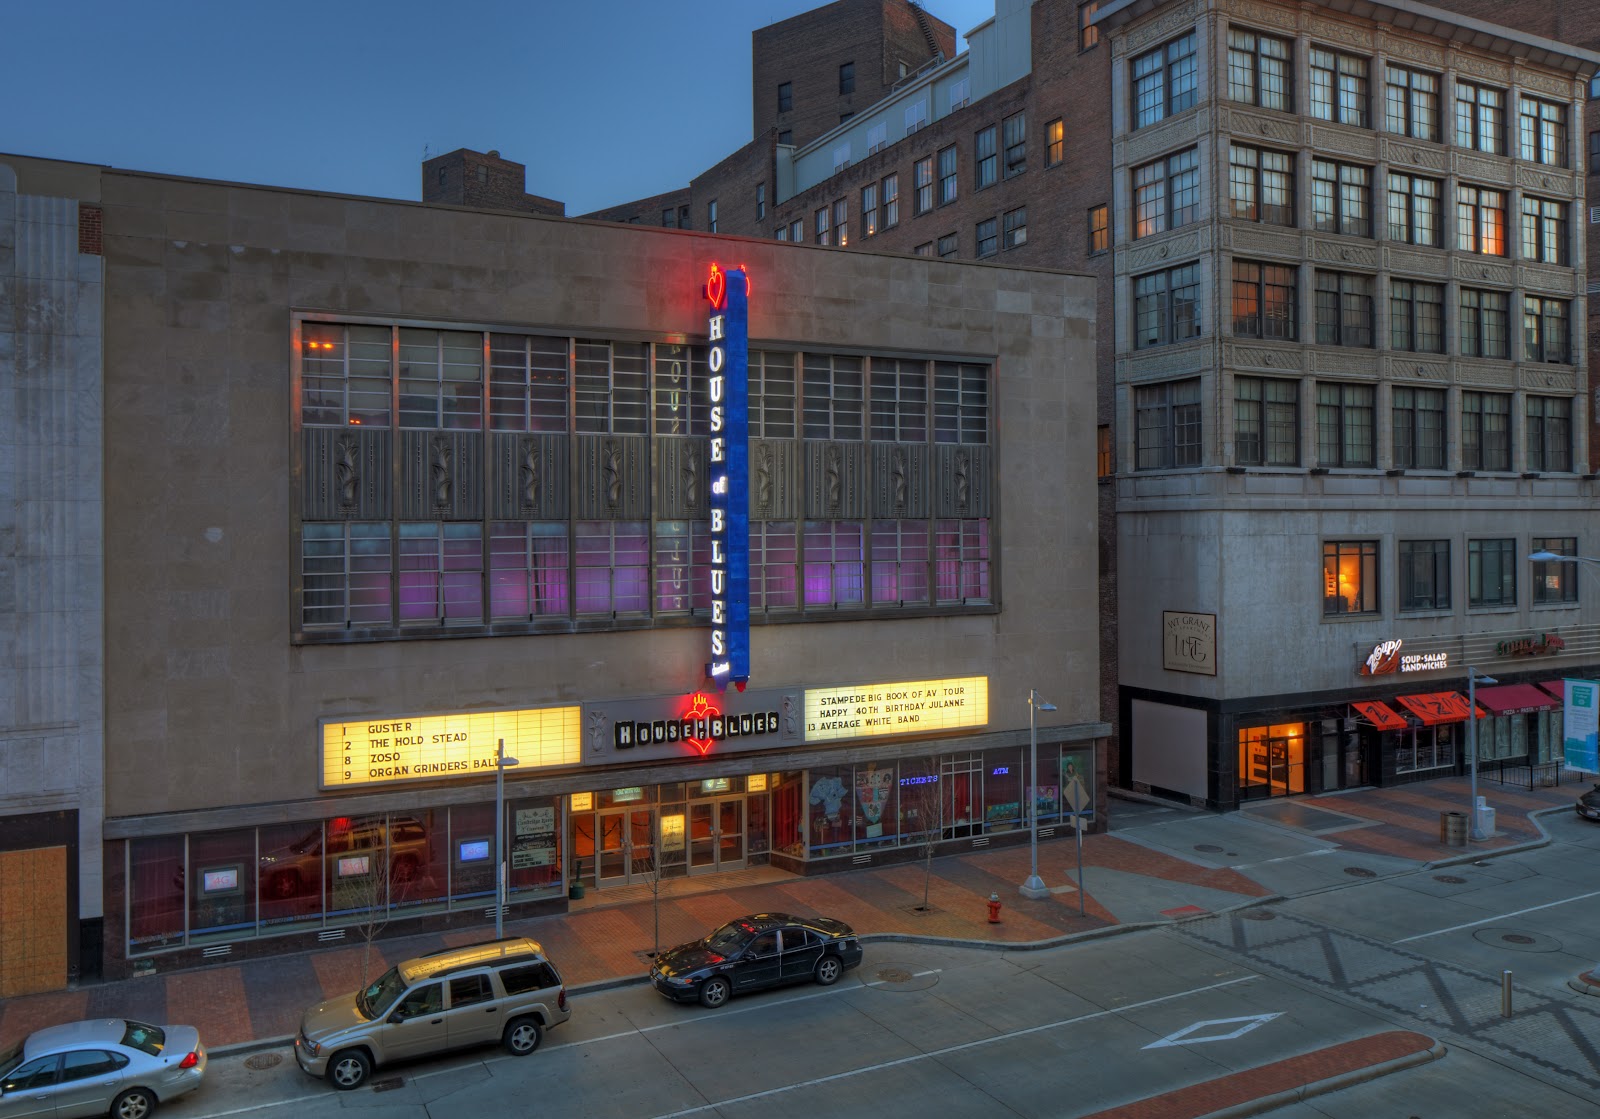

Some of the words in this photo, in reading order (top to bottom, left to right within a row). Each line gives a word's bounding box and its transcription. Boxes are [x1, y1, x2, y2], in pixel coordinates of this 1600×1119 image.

[709, 315, 724, 462] HOUSE
[711, 509, 726, 655] BLUES
[1183, 616, 1210, 632] GRANT
[1401, 661, 1447, 672] SANDWICHES
[820, 695, 866, 706] STAMPEDE
[868, 693, 882, 702] BIG
[886, 691, 908, 701] BOOK
[911, 690, 923, 699] OF
[926, 689, 937, 698] AV
[943, 687, 965, 696] TOUR
[820, 708, 848, 718] HAPPY
[856, 706, 879, 715] 40TH
[885, 702, 926, 713] BIRTHDAY
[928, 699, 965, 709] JULANNE
[368, 722, 413, 734] GUSTER
[618, 722, 692, 746] HOUSE
[711, 715, 778, 738] BLUES
[808, 723, 816, 732] 13
[820, 720, 861, 731] AVERAGE
[865, 717, 892, 727] WHITE
[898, 714, 920, 724] BAND
[345, 741, 352, 750] 2
[370, 738, 390, 749] THE
[395, 735, 424, 747] HOLD
[432, 732, 468, 744] STEAD
[345, 756, 352, 765] 8
[370, 752, 401, 763] ZOSO
[344, 771, 352, 780] 9
[369, 765, 409, 778] ORGAN
[413, 760, 468, 773] GRINDERS
[993, 767, 1009, 776] ATM
[900, 774, 939, 786] TICKETS
